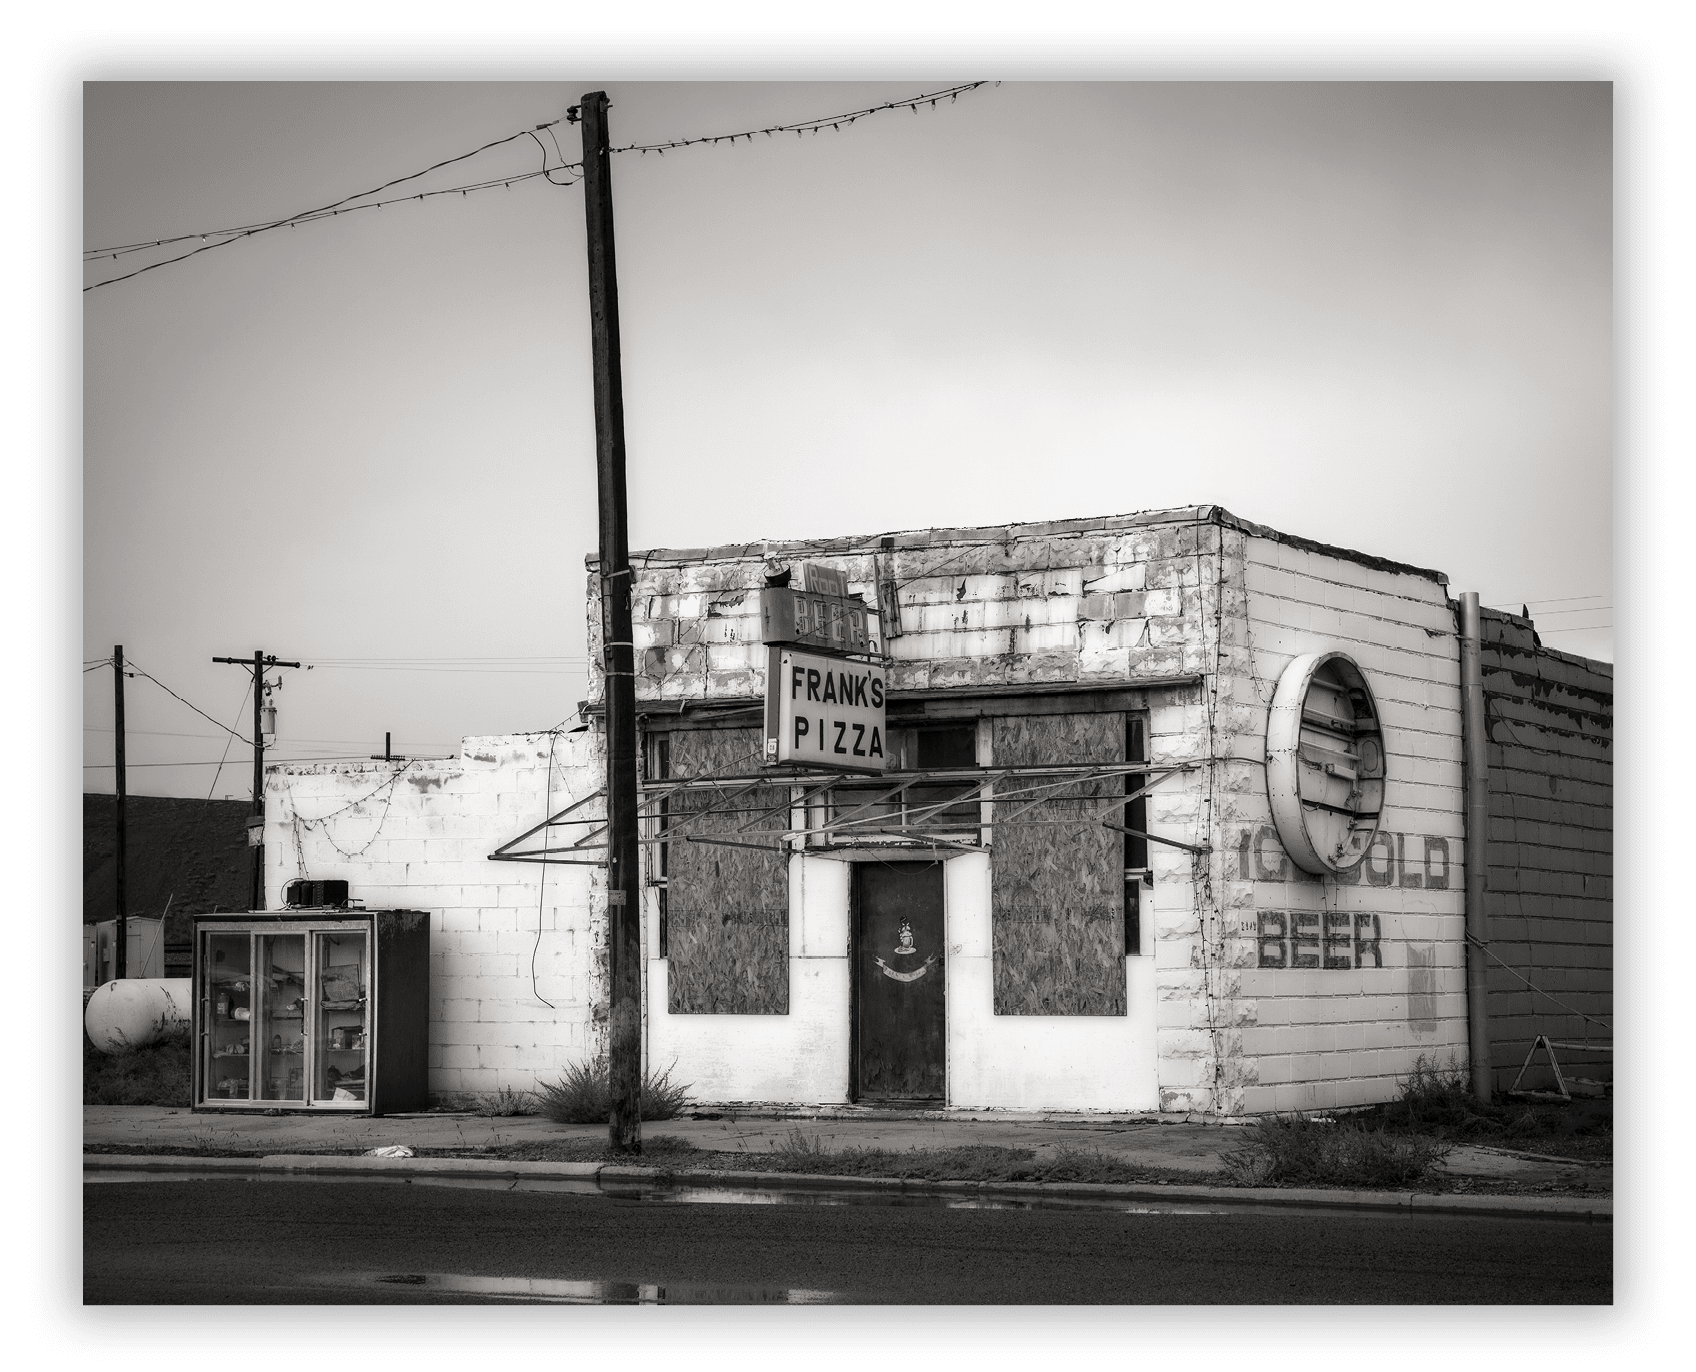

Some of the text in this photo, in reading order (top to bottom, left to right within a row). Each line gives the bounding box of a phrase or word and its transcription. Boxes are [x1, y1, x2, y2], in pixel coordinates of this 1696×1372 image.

[794, 596, 866, 646] BEER
[792, 666, 884, 708] FRANK'S
[795, 716, 884, 758] PIZZA
[1238, 825, 1321, 883] IC
[1257, 911, 1382, 969] BEER
